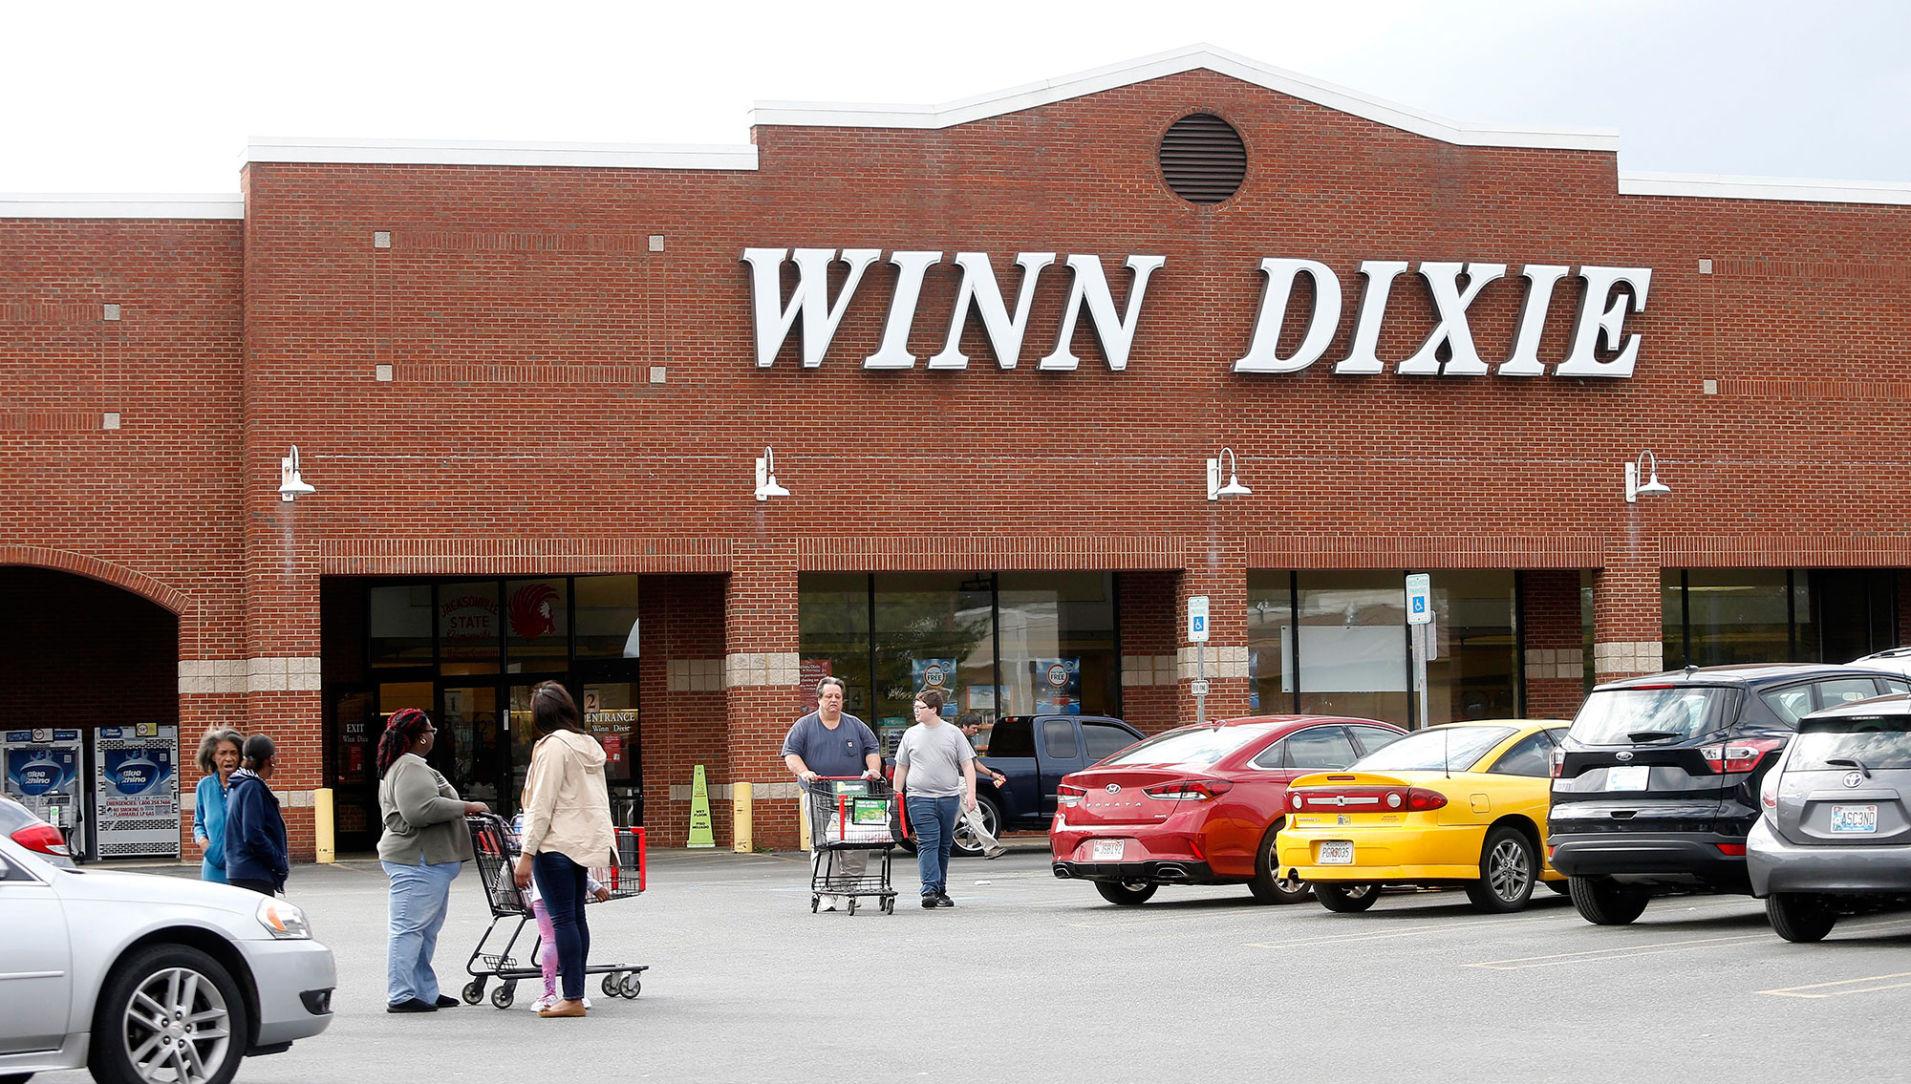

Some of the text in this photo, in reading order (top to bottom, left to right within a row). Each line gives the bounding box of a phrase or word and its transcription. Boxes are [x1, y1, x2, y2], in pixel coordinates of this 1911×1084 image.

[740, 247, 1653, 379] WINN DIXIE
[450, 615, 490, 629] STATE
[586, 694, 596, 709] 2
[586, 712, 635, 722] ENTRANCE
[346, 723, 364, 733] EXIT
[613, 724, 630, 732] Dixie
